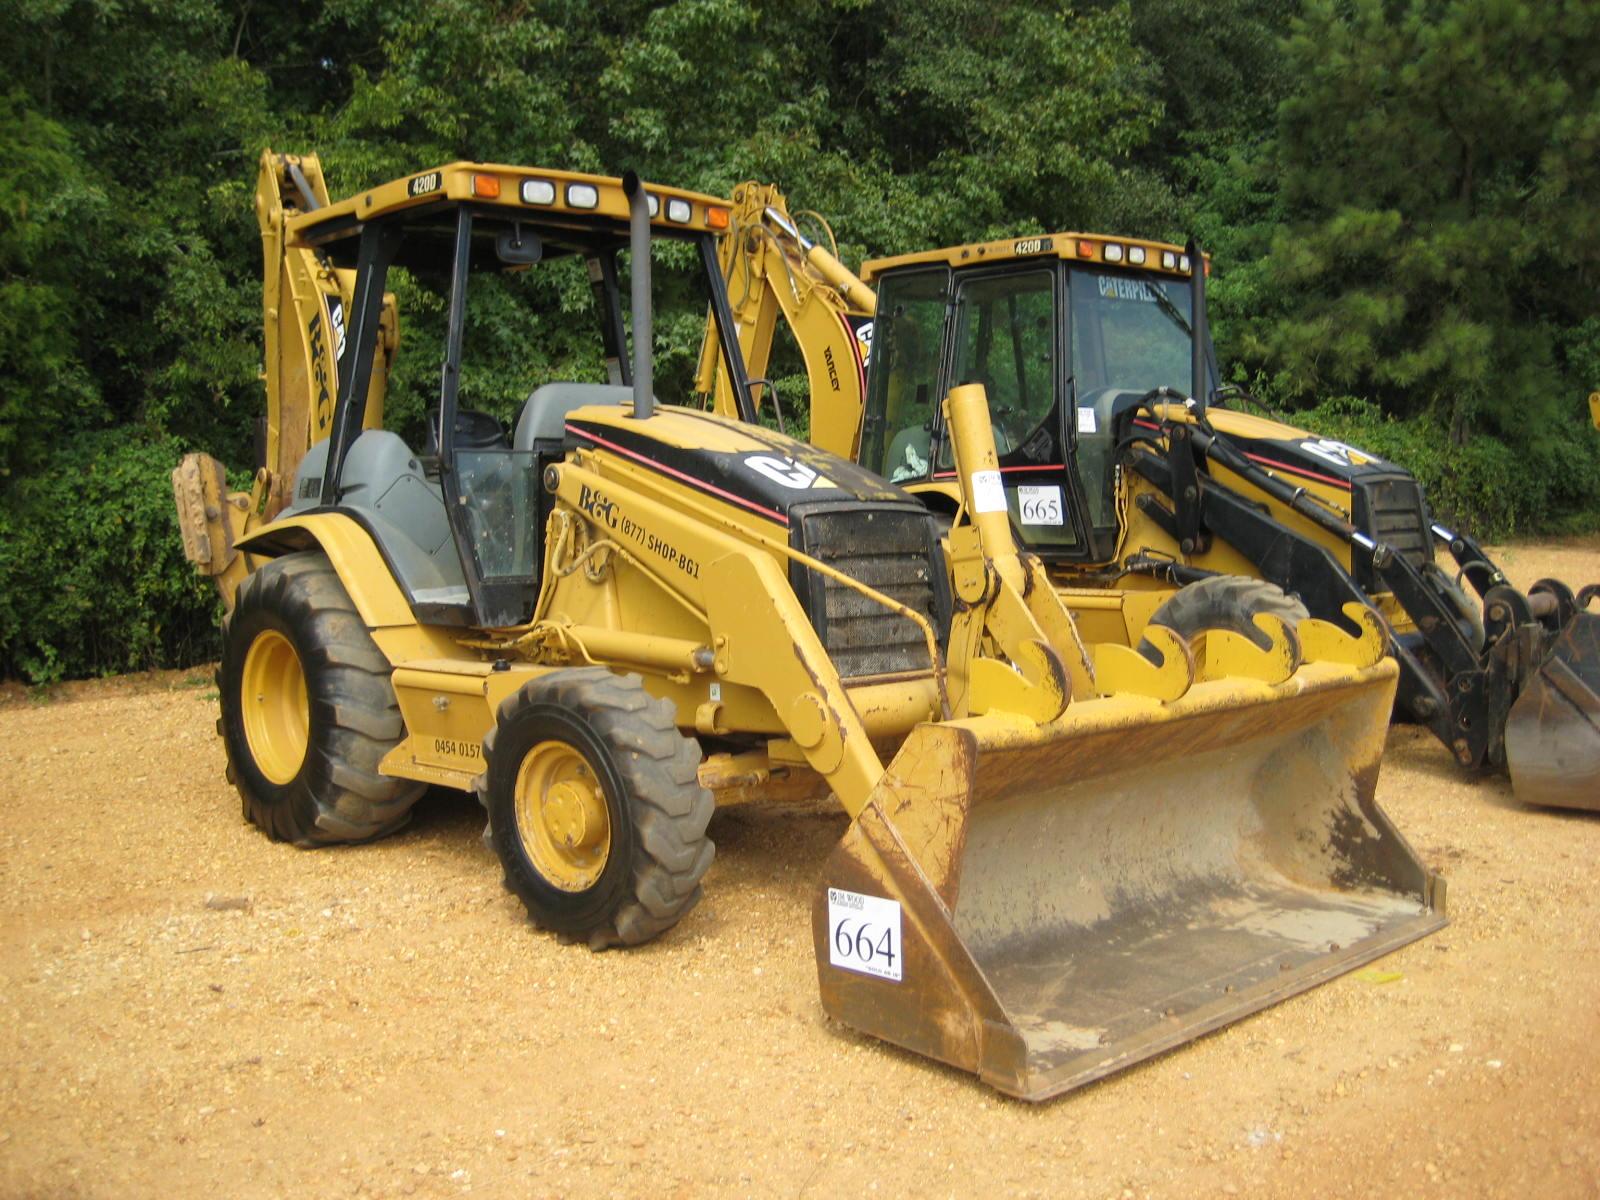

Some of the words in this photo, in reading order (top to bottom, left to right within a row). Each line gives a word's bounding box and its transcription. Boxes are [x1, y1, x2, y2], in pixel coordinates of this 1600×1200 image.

[412, 173, 437, 196] 420D
[1015, 239, 1041, 255] 420D
[1098, 275, 1168, 303] CATERPILL
[1023, 499, 1058, 521] 665
[620, 516, 646, 545] (877)
[647, 534, 700, 579] SHOP-BG1
[435, 739, 456, 756] 0454
[459, 742, 480, 759] 0157
[835, 917, 896, 968] 664
